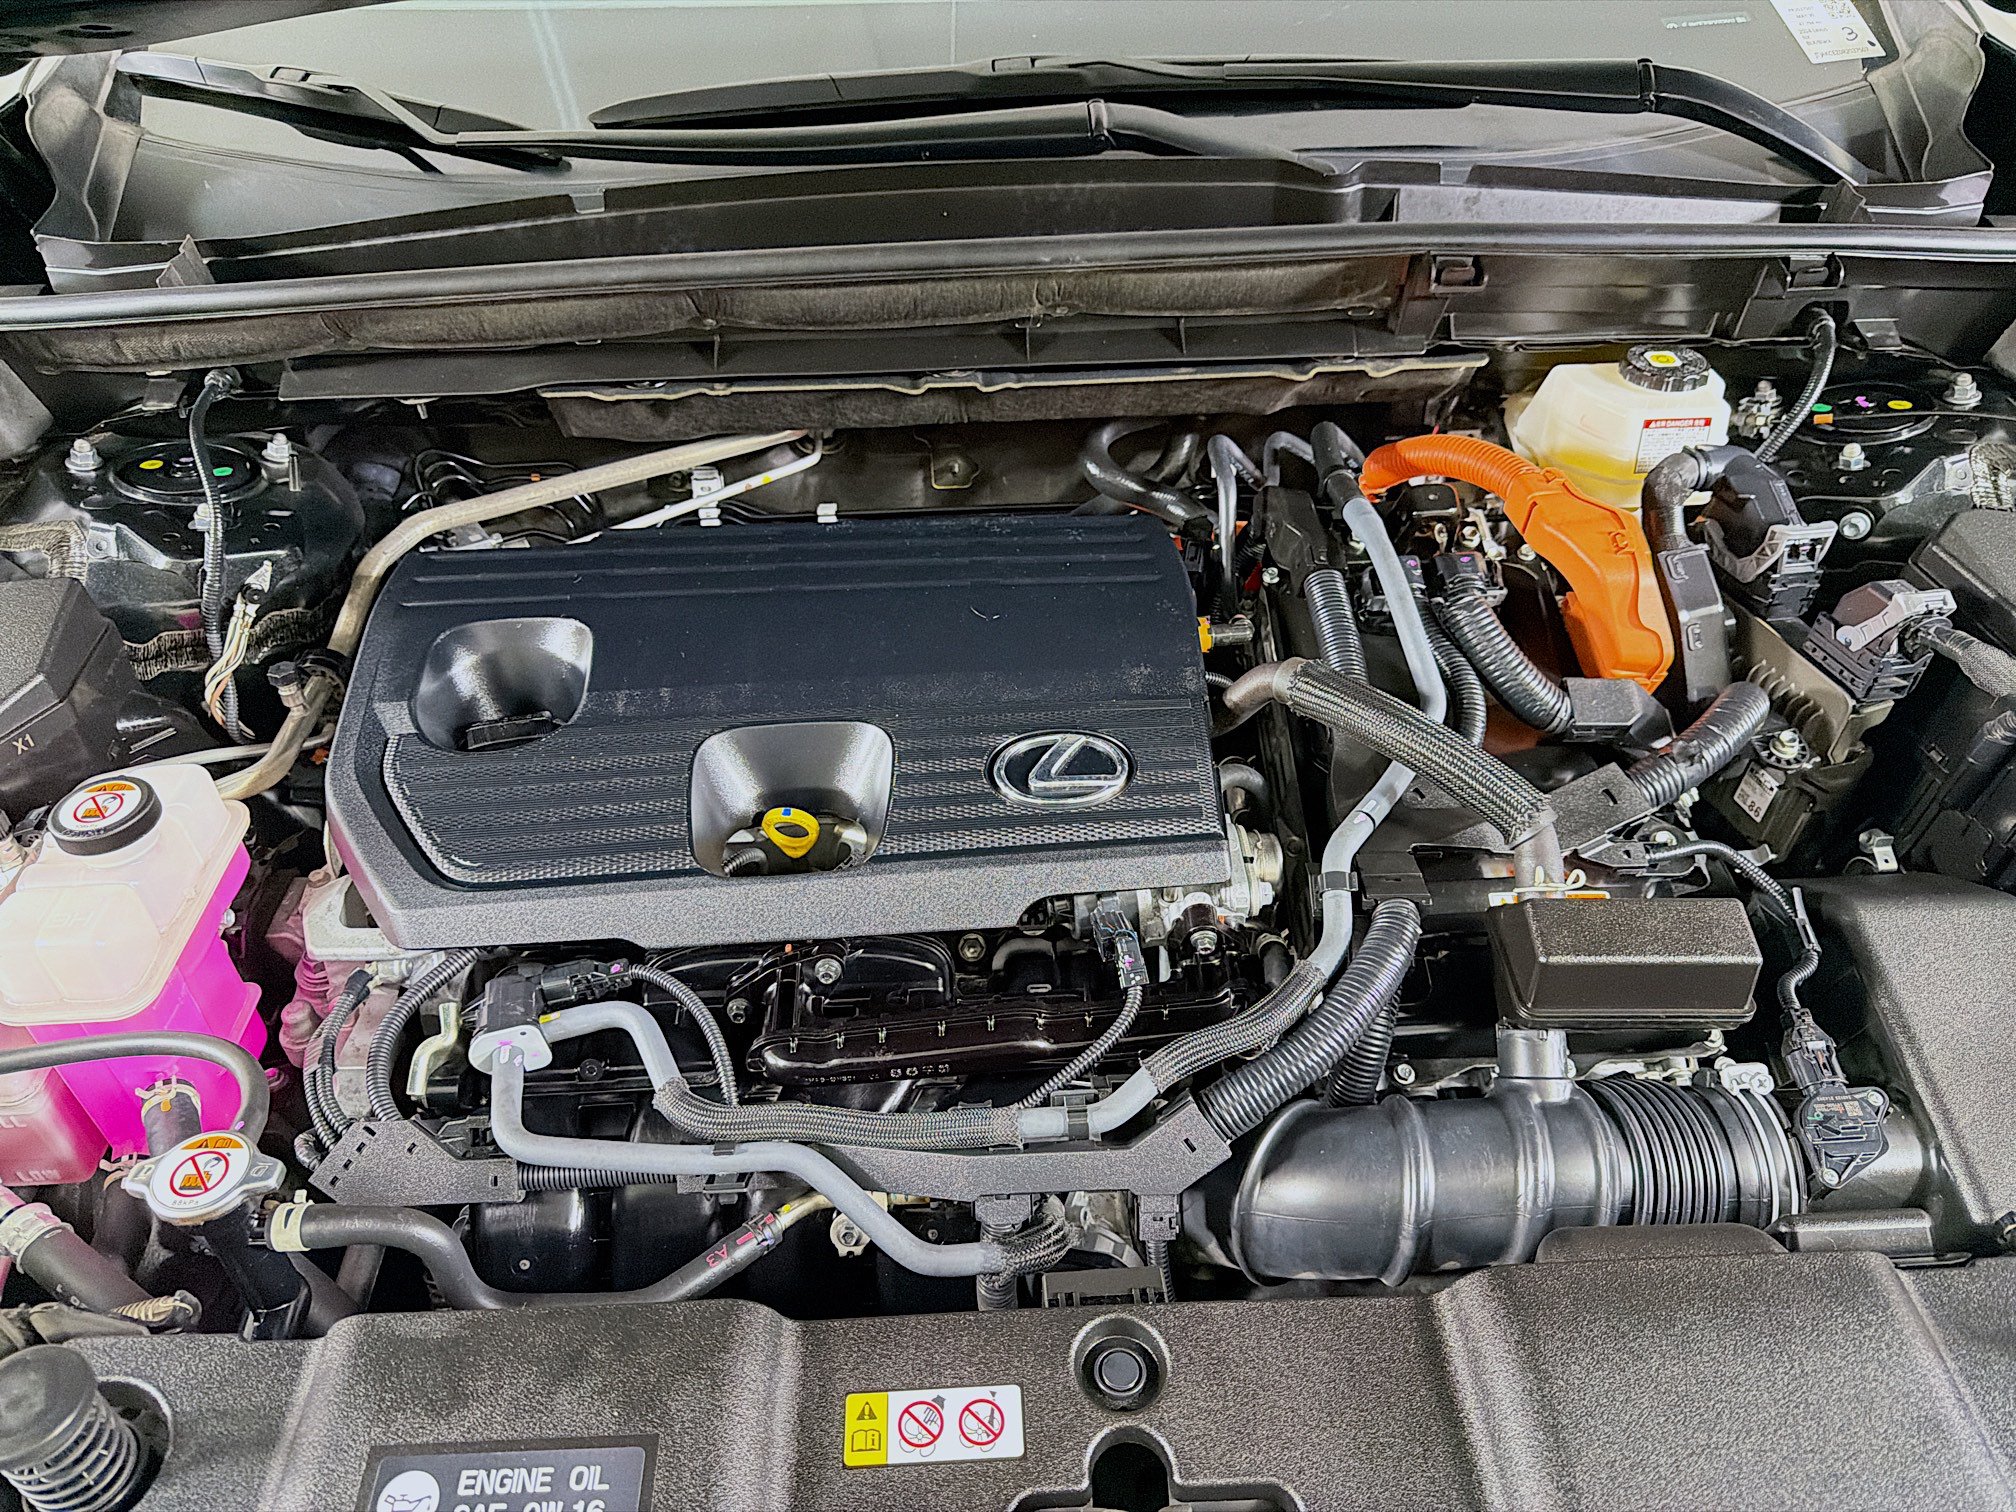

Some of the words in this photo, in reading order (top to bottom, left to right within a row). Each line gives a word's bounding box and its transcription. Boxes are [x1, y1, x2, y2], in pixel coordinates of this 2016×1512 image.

[1841, 26, 1858, 41] 3
[1666, 419, 1694, 428] DANGER
[11, 733, 35, 755] X1
[1747, 800, 1762, 818] 86
[706, 1243, 728, 1268] A3
[457, 1467, 555, 1496] ENGINE
[569, 1465, 610, 1491] OIL
